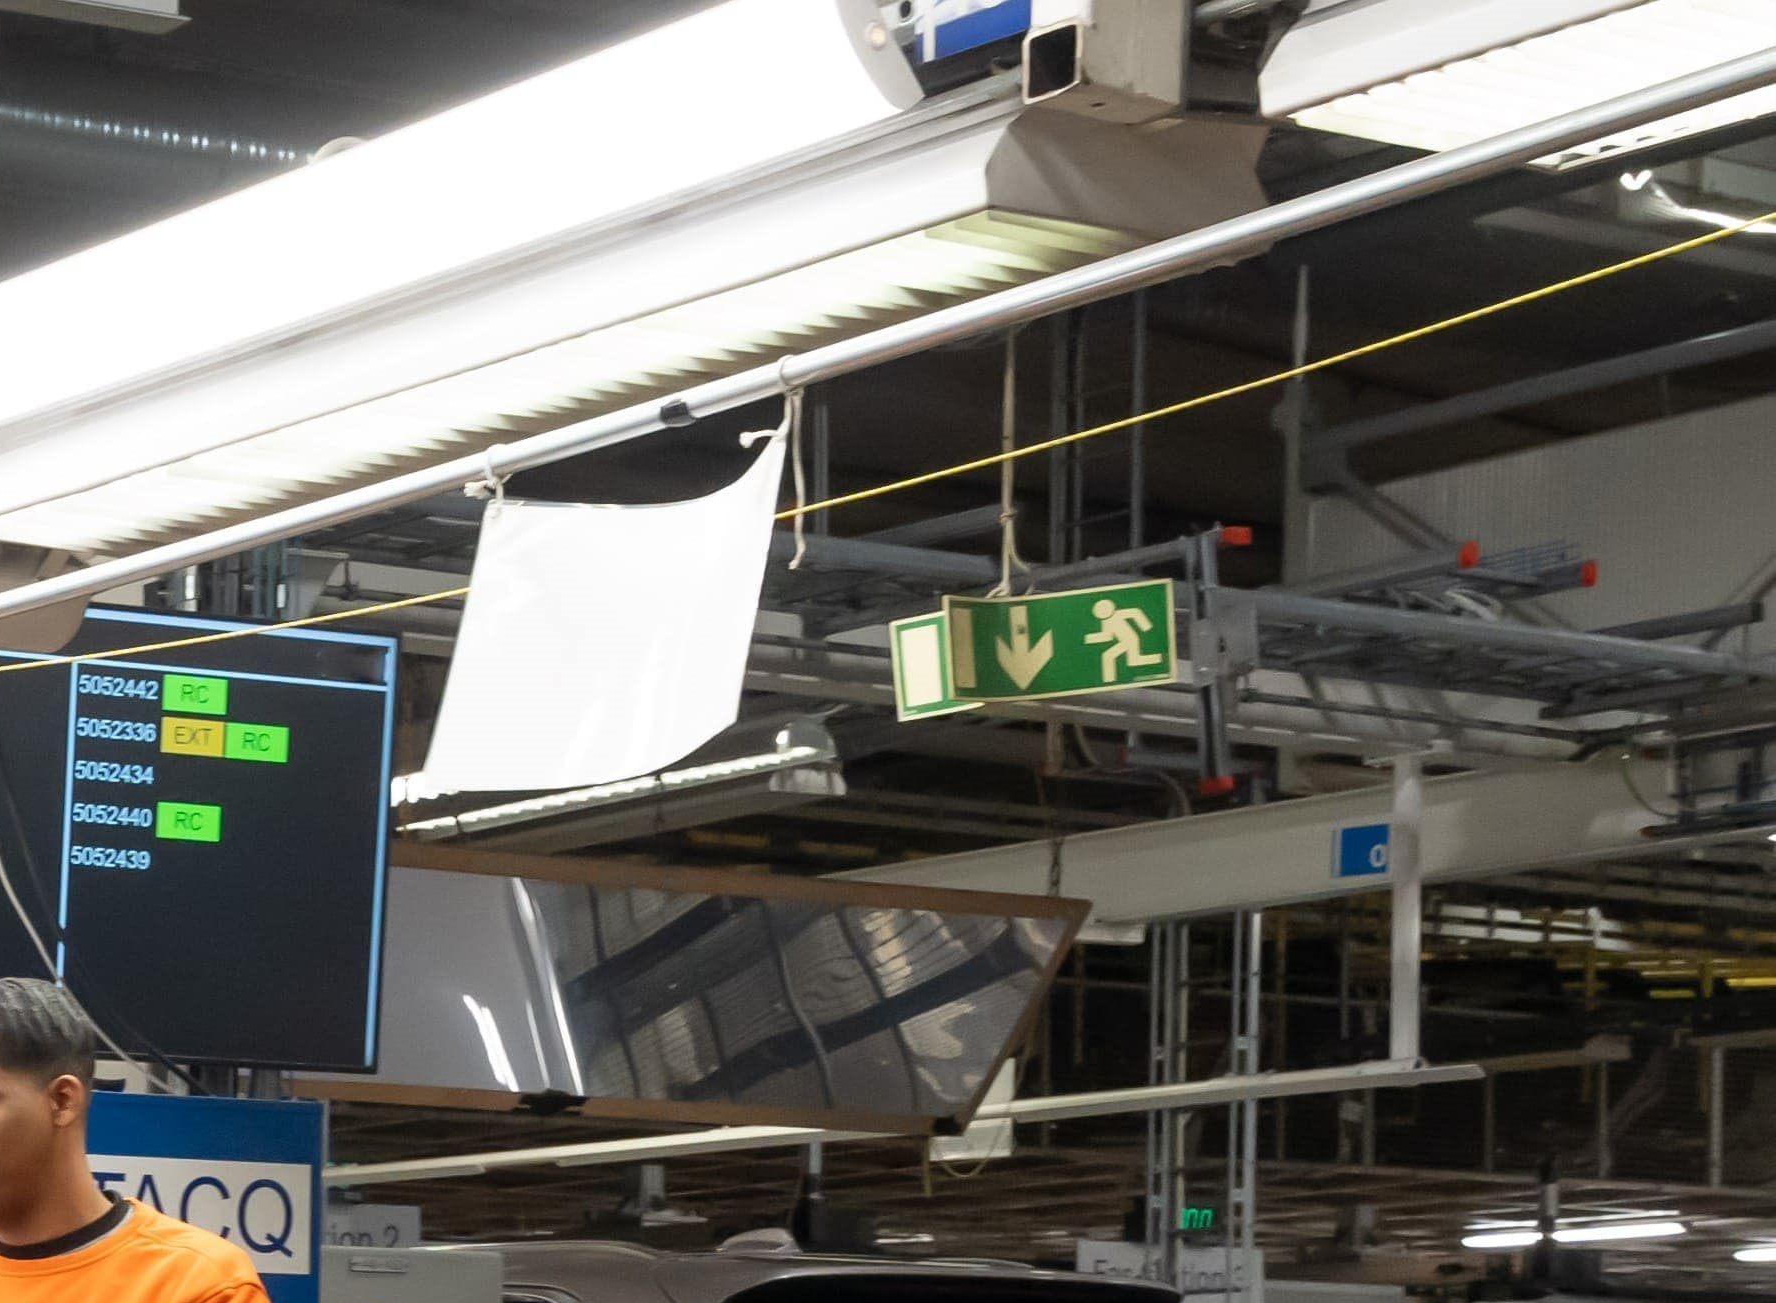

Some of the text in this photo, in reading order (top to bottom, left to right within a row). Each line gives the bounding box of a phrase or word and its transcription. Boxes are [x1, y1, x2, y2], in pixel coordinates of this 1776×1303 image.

[78, 674, 210, 704] 5052442 RC
[76, 717, 271, 752] 5052336 EXT RC
[74, 760, 155, 784] 5052434
[72, 803, 204, 831] 5052440 RC
[70, 846, 151, 869] 5052439
